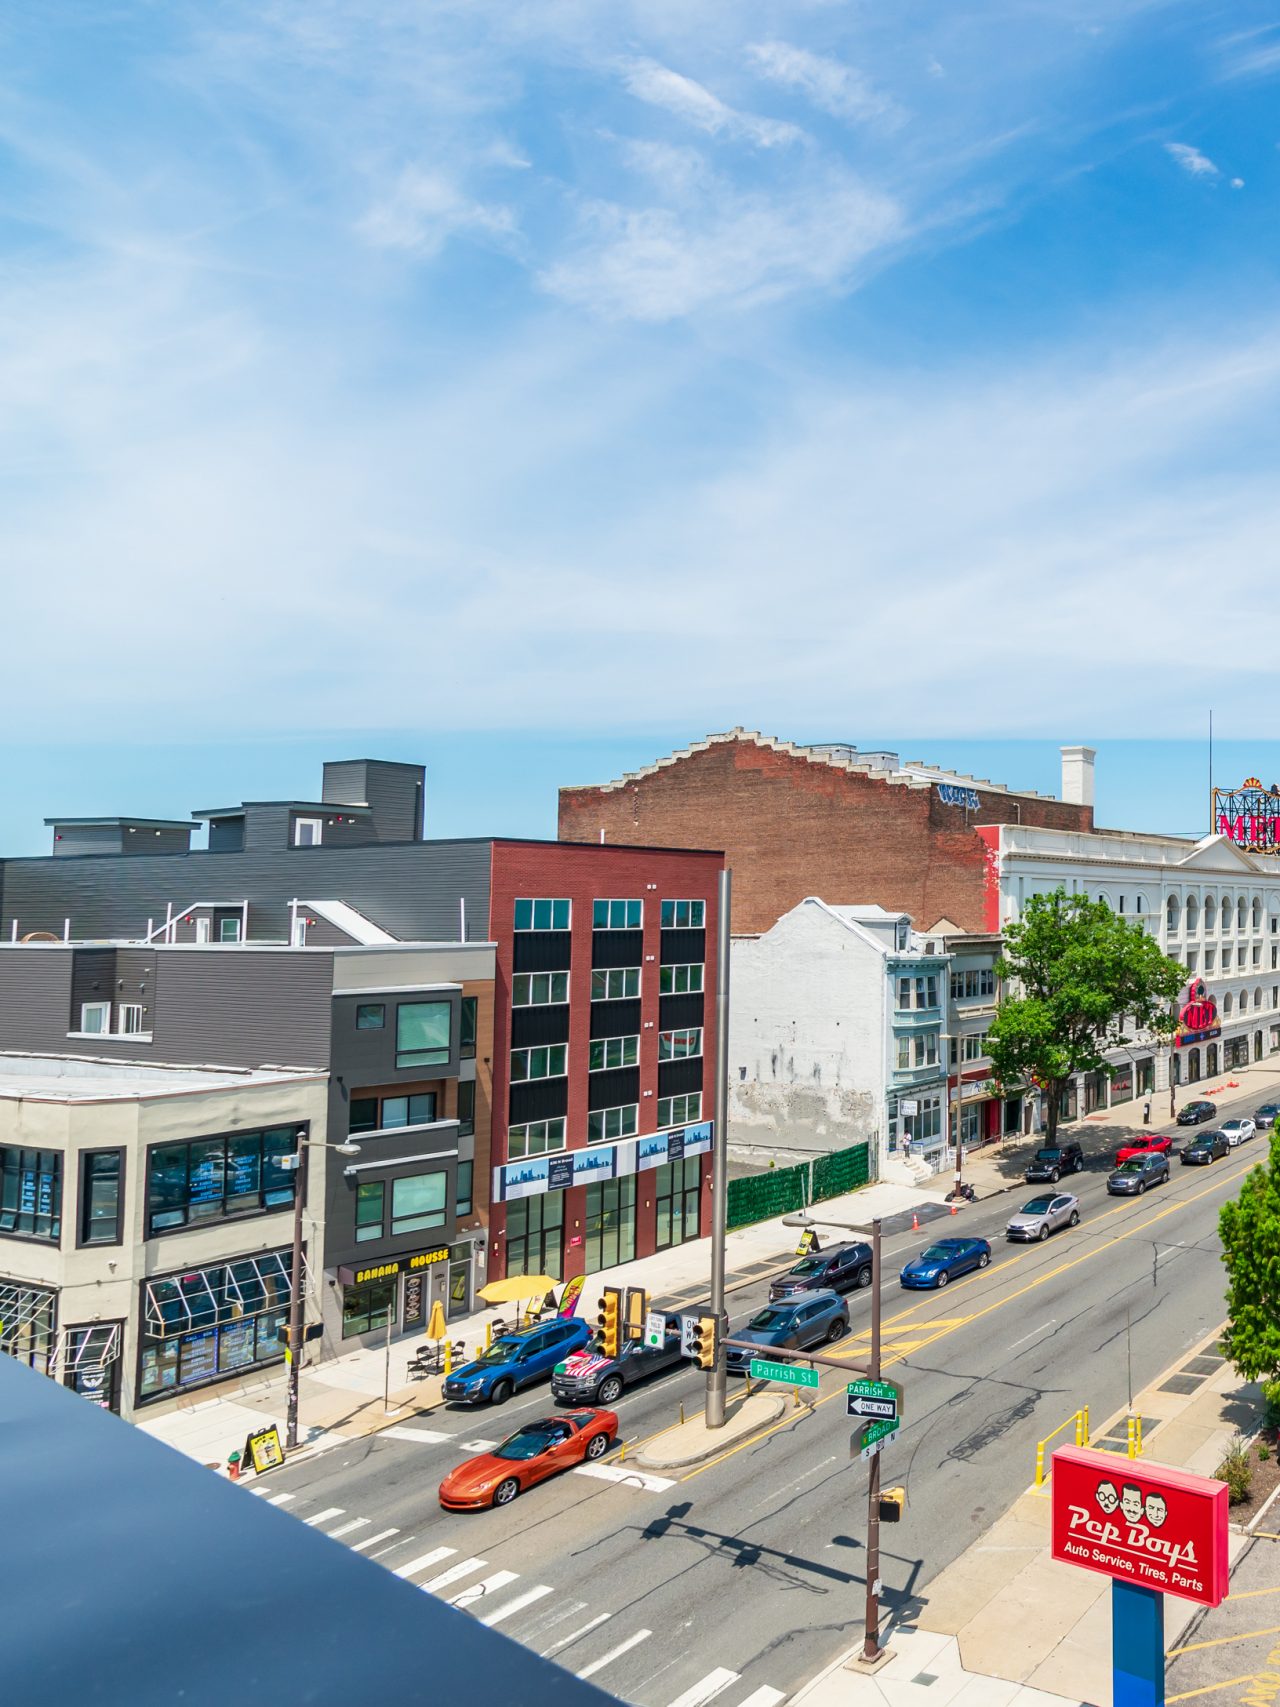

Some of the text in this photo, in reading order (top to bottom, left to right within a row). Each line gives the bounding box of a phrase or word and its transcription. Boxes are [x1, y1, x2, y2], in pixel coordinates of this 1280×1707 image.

[357, 1248, 449, 1283] BANANA MOUSSE
[756, 1364, 812, 1384] Parrish St
[848, 1384, 883, 1396] PARRISH
[861, 1402, 891, 1413] ONE WAY
[868, 1422, 891, 1442] BROAD
[866, 1448, 870, 1457] S
[891, 1432, 895, 1441] N
[1068, 1504, 1198, 1567] Pep Boys
[1064, 1541, 1203, 1592] Auto Service, Tires, Parts
